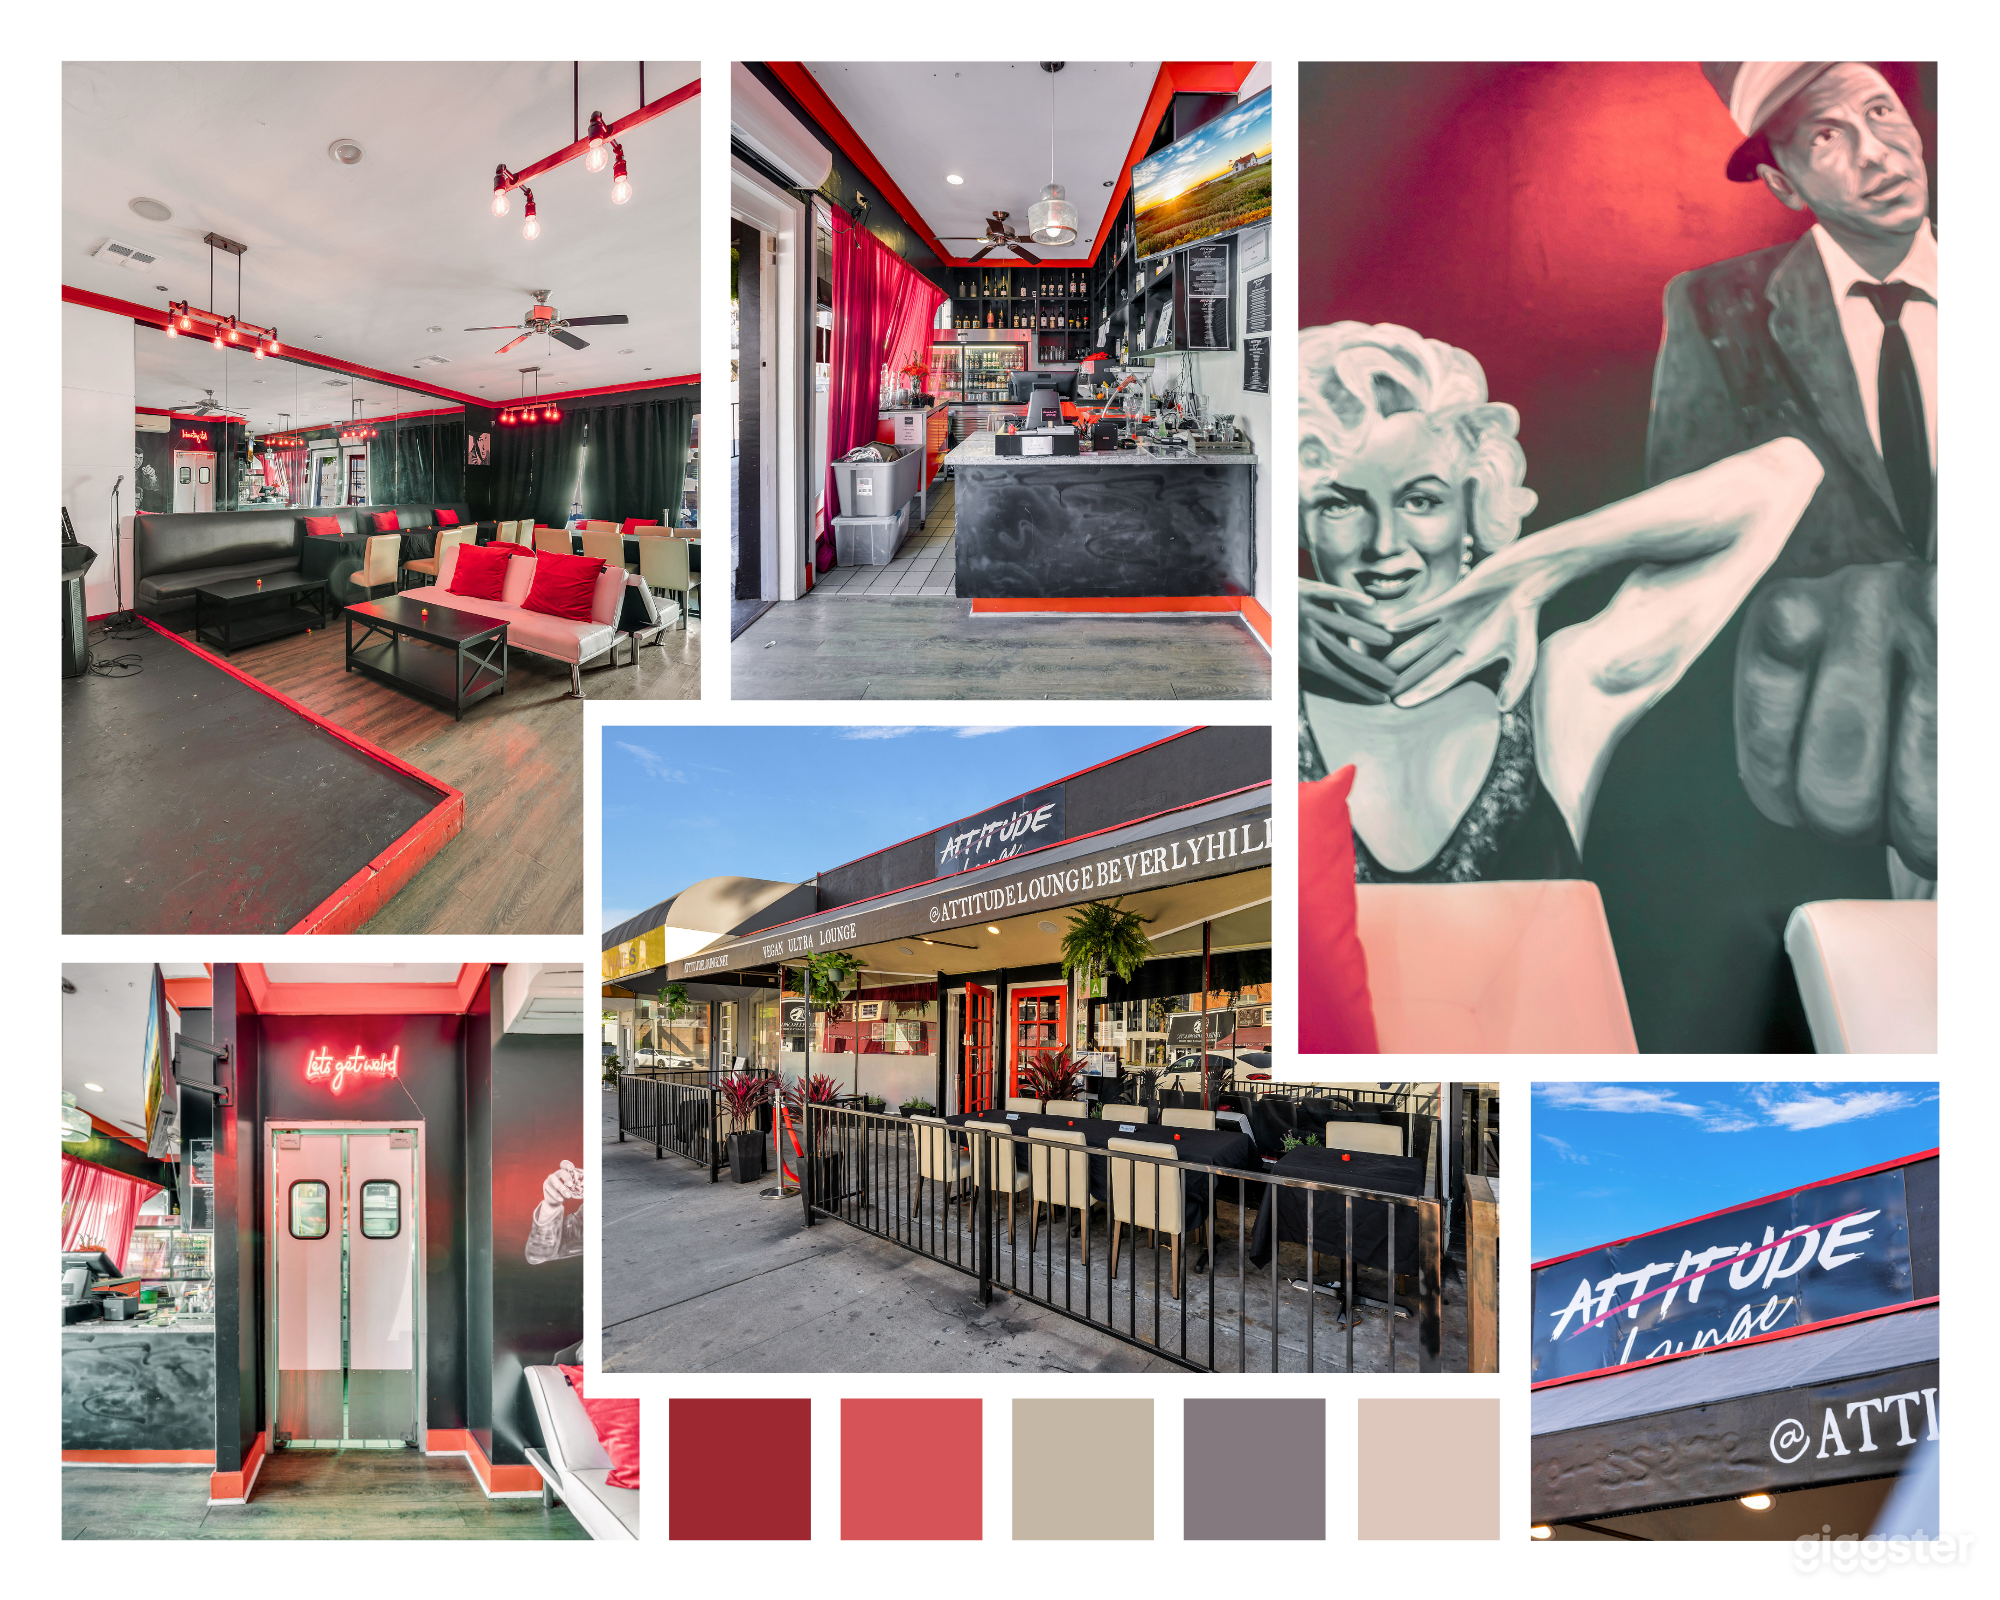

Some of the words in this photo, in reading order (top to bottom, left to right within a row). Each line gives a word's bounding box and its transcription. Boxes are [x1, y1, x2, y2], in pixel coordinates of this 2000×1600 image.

[940, 803, 1056, 865] ATTITUDE
[608, 947, 636, 972] NAILS
[762, 941, 784, 959] VEGAN
[788, 934, 814, 952] ULTRA
[819, 922, 857, 946] LOUNGE
[1091, 984, 1100, 994] A
[306, 1045, 334, 1078] Lets
[332, 1045, 364, 1091] get
[364, 1045, 399, 1077] weird
[1550, 1209, 1881, 1342] ATTITUDE
[1770, 1387, 1940, 1464] @ATTI
